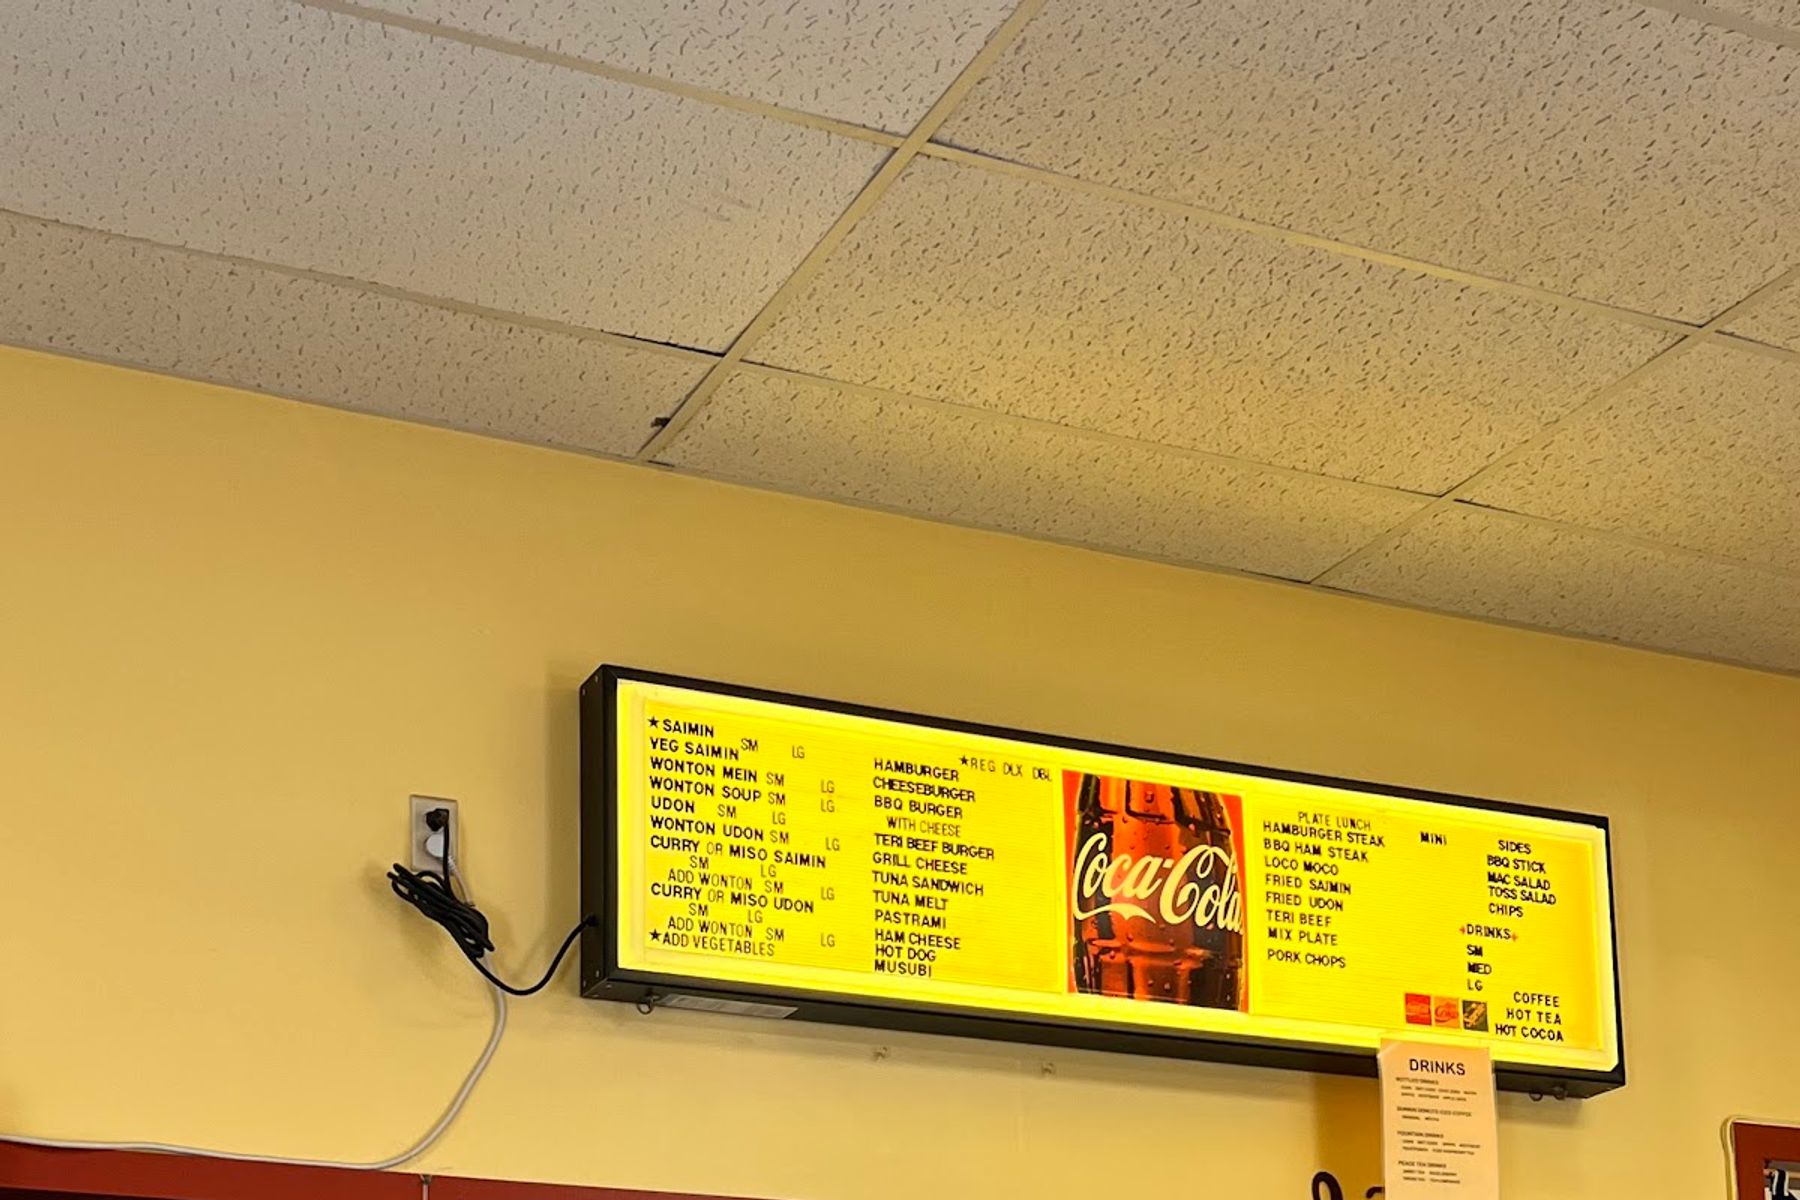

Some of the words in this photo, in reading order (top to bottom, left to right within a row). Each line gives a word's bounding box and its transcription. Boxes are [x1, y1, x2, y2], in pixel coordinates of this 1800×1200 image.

[650, 736, 678, 752] VEG
[685, 743, 739, 760] SAIMIN
[663, 719, 714, 737] SAIMIN
[741, 739, 758, 751] SM
[792, 746, 805, 758] LG
[650, 757, 715, 776] WONTON
[723, 767, 757, 782] MEIN
[767, 773, 784, 786] SM
[821, 780, 835, 793] LG
[874, 758, 959, 781] HAMBURGER
[971, 757, 995, 772] REG
[1003, 763, 1023, 776] DLX
[650, 776, 714, 796] WONTON
[722, 787, 761, 802] SOUP
[768, 792, 785, 805] SM
[821, 800, 835, 812] LG
[873, 777, 976, 802] CHEESEBURGER
[651, 797, 695, 813] UDON
[718, 804, 736, 818] SM
[773, 812, 786, 824] LG
[875, 795, 902, 810] BBQ
[910, 800, 962, 818] BURGER
[650, 816, 715, 834] WONTON
[723, 825, 763, 841] UDON
[770, 830, 789, 844] SM
[826, 838, 840, 851] LG
[887, 816, 915, 831] WITH
[920, 821, 960, 837] CHEESE
[1263, 821, 1342, 841] HAMBURGER
[1347, 832, 1385, 847] STEAK
[1298, 811, 1330, 826] PLATE
[1337, 817, 1371, 830] LUNCH
[1420, 832, 1447, 845] MINI
[650, 835, 700, 853] CURRY
[707, 842, 722, 855] OR
[730, 845, 768, 861] MISO
[774, 851, 826, 867] SAIMIN
[874, 833, 902, 848] TERI
[907, 837, 937, 852] BEEF
[942, 842, 994, 860] BURGER
[1264, 839, 1290, 852] BBQ
[1295, 843, 1321, 855] HAM
[1329, 847, 1368, 862] STEAK
[1499, 840, 1531, 855] SIDES
[689, 856, 709, 869] SM
[761, 865, 776, 877] LG
[873, 852, 910, 868] GRILL
[916, 858, 967, 875] CHEESE
[1265, 856, 1298, 870] LOCO
[1304, 861, 1339, 875] MOCO
[1487, 855, 1509, 868] BBQ
[1514, 859, 1546, 874] STICK
[668, 869, 694, 883] ADD
[699, 873, 752, 890] WONTON
[765, 881, 783, 894] SM
[821, 888, 835, 900] LG
[872, 870, 908, 886] TUNA
[912, 876, 983, 896] SANDWICH
[1074, 832, 1243, 935] Coca-Cola
[1265, 873, 1302, 888] FRIED
[1309, 879, 1351, 894] SAIMIN
[1488, 872, 1510, 885] MAC
[1514, 876, 1550, 891] SALAD
[651, 883, 701, 900] CURRY
[708, 890, 724, 902] OR
[730, 893, 768, 907] MISO
[774, 897, 814, 913] UDON
[873, 890, 910, 906] TUNA
[915, 895, 948, 910] MELT
[1265, 891, 1302, 906] FRIED
[1309, 897, 1343, 911] UDON
[1489, 886, 1517, 900] TOSS
[1520, 890, 1556, 905] SALAD
[689, 903, 708, 916] SM
[748, 911, 763, 924] LG
[875, 909, 946, 928] PASTRAMI
[1266, 909, 1294, 923] TERI
[1300, 913, 1331, 927] BEEF
[1489, 903, 1523, 918] CHIPS
[668, 916, 693, 931] ADD
[699, 921, 752, 938] WONTON
[766, 928, 784, 941] SM
[821, 934, 835, 947] LG
[875, 928, 904, 943] HAM
[909, 932, 960, 949] CHEESE
[1268, 927, 1292, 940] MIX
[1300, 931, 1337, 945] PLATE
[1467, 924, 1511, 940] DRINKS
[663, 932, 689, 947] ADD
[693, 936, 775, 956] VEGETABLES
[876, 944, 902, 958] HOT
[908, 948, 936, 962] DOG
[1467, 945, 1483, 957] SM
[875, 960, 932, 977] MUSUBI
[1267, 949, 1300, 963] PORK
[1305, 953, 1345, 968] CHOPS
[1468, 962, 1492, 975] MED
[1468, 979, 1483, 991] LG
[1514, 991, 1559, 1008] COFFEE
[1507, 1009, 1531, 1021] HOT
[1537, 1012, 1562, 1025] TEA
[1495, 1024, 1517, 1036] HOT
[1521, 1026, 1564, 1042] COCOA
[1409, 1058, 1466, 1075] DRINKS
